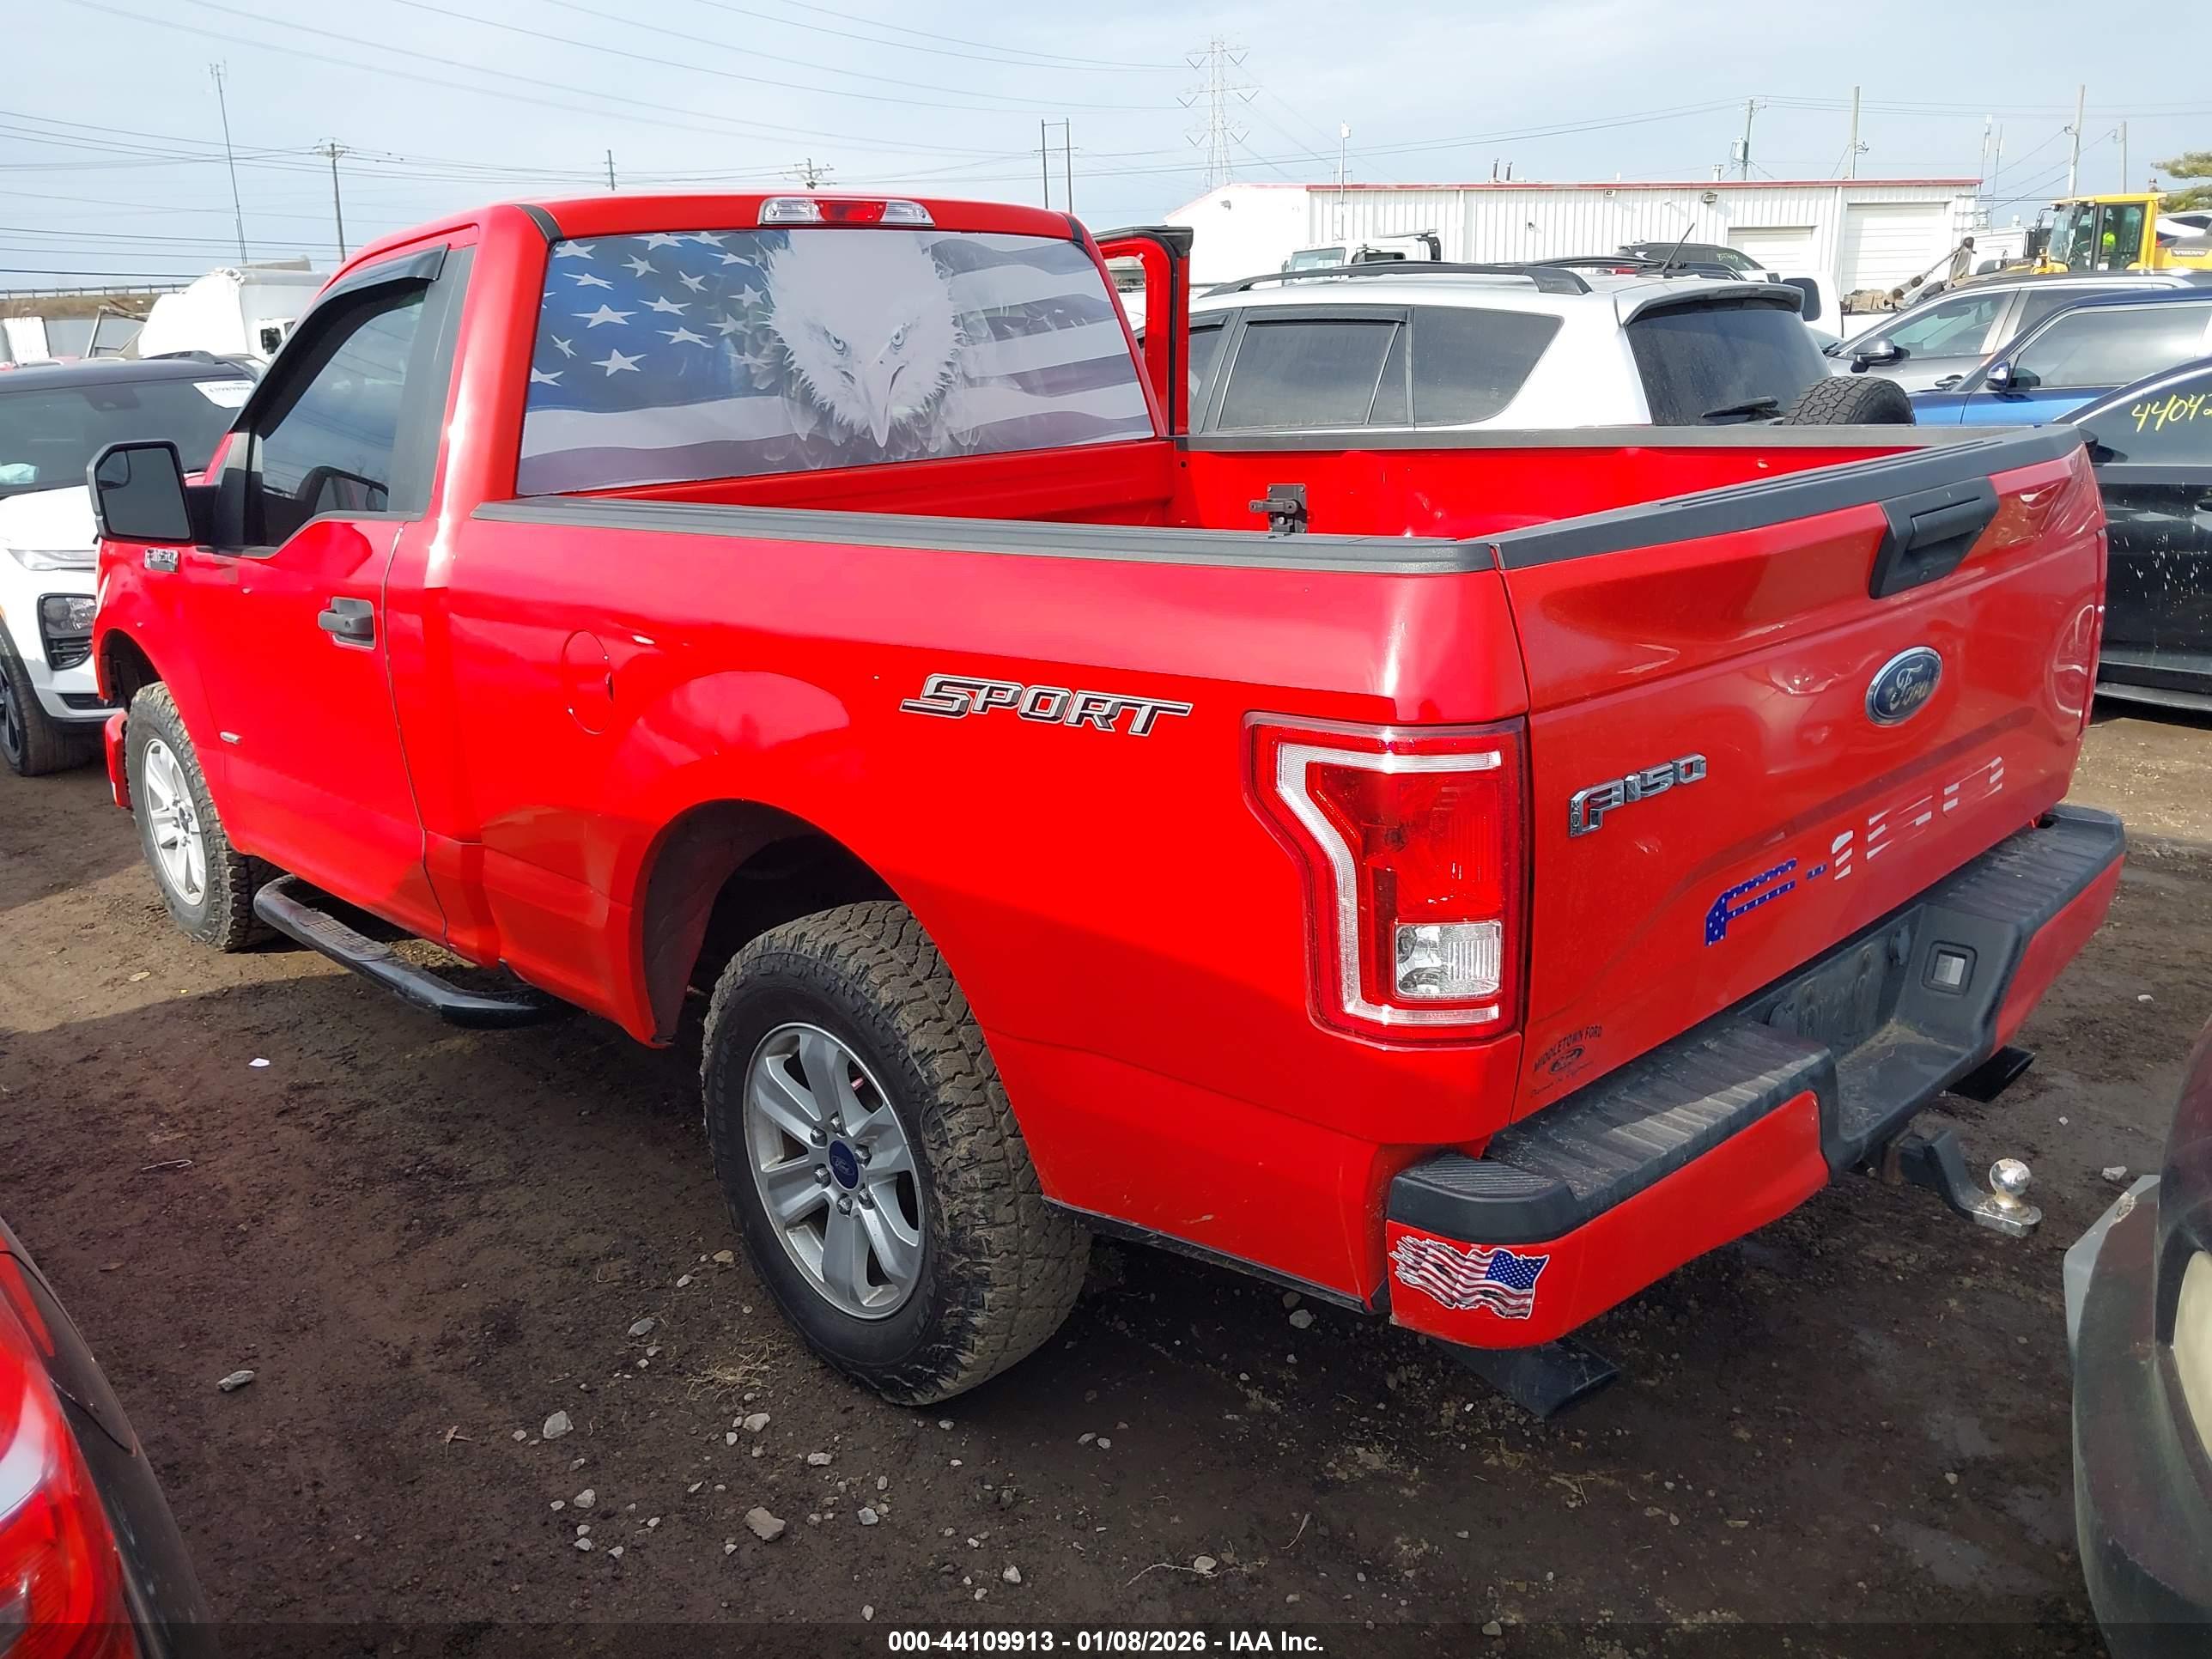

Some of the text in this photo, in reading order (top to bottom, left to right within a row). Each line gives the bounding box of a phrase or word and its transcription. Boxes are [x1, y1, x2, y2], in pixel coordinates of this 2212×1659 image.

[900, 673, 1194, 736] SPORT
[1890, 664, 1932, 711] Ford
[1534, 1030, 1583, 1073] MIDDLETOWN
[1584, 1024, 1602, 1040] FORD
